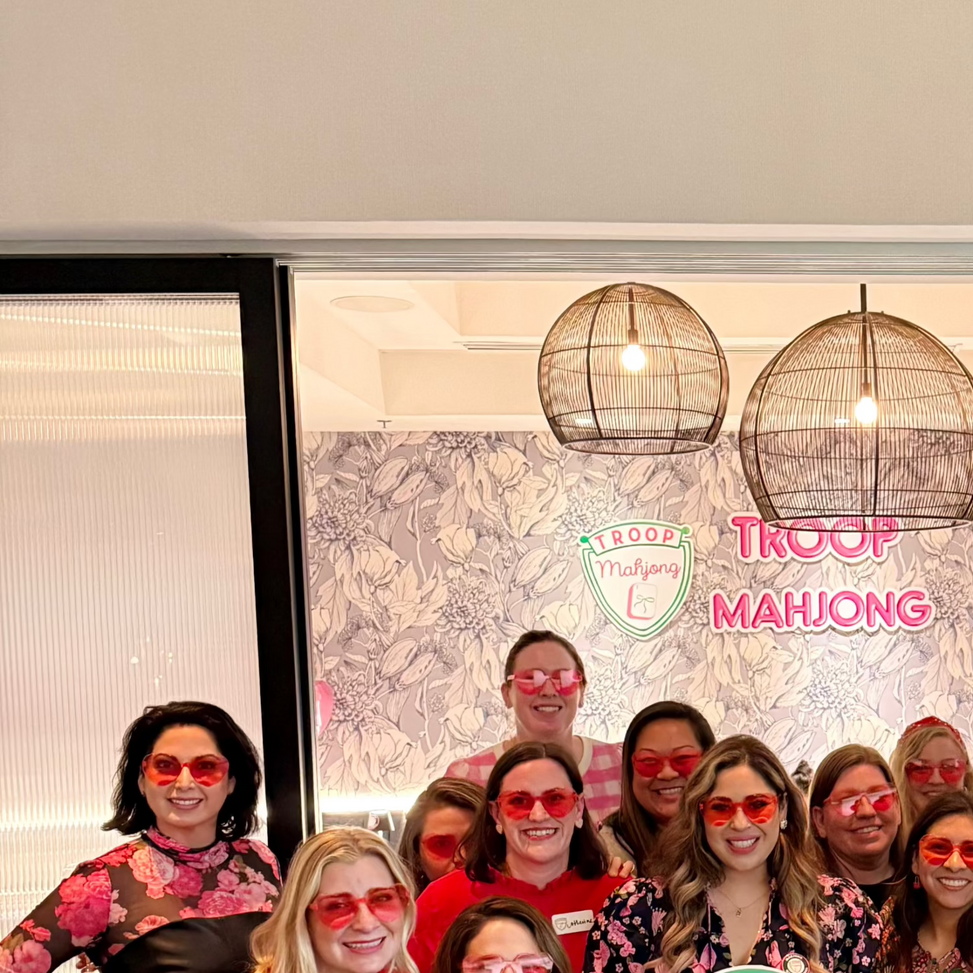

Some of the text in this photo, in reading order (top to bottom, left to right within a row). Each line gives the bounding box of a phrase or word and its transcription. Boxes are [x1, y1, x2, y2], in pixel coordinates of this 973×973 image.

[594, 527, 674, 550] TROOP
[732, 516, 899, 558] TROOP
[595, 558, 681, 581] Mahjong
[713, 590, 932, 629] MAHJONG
